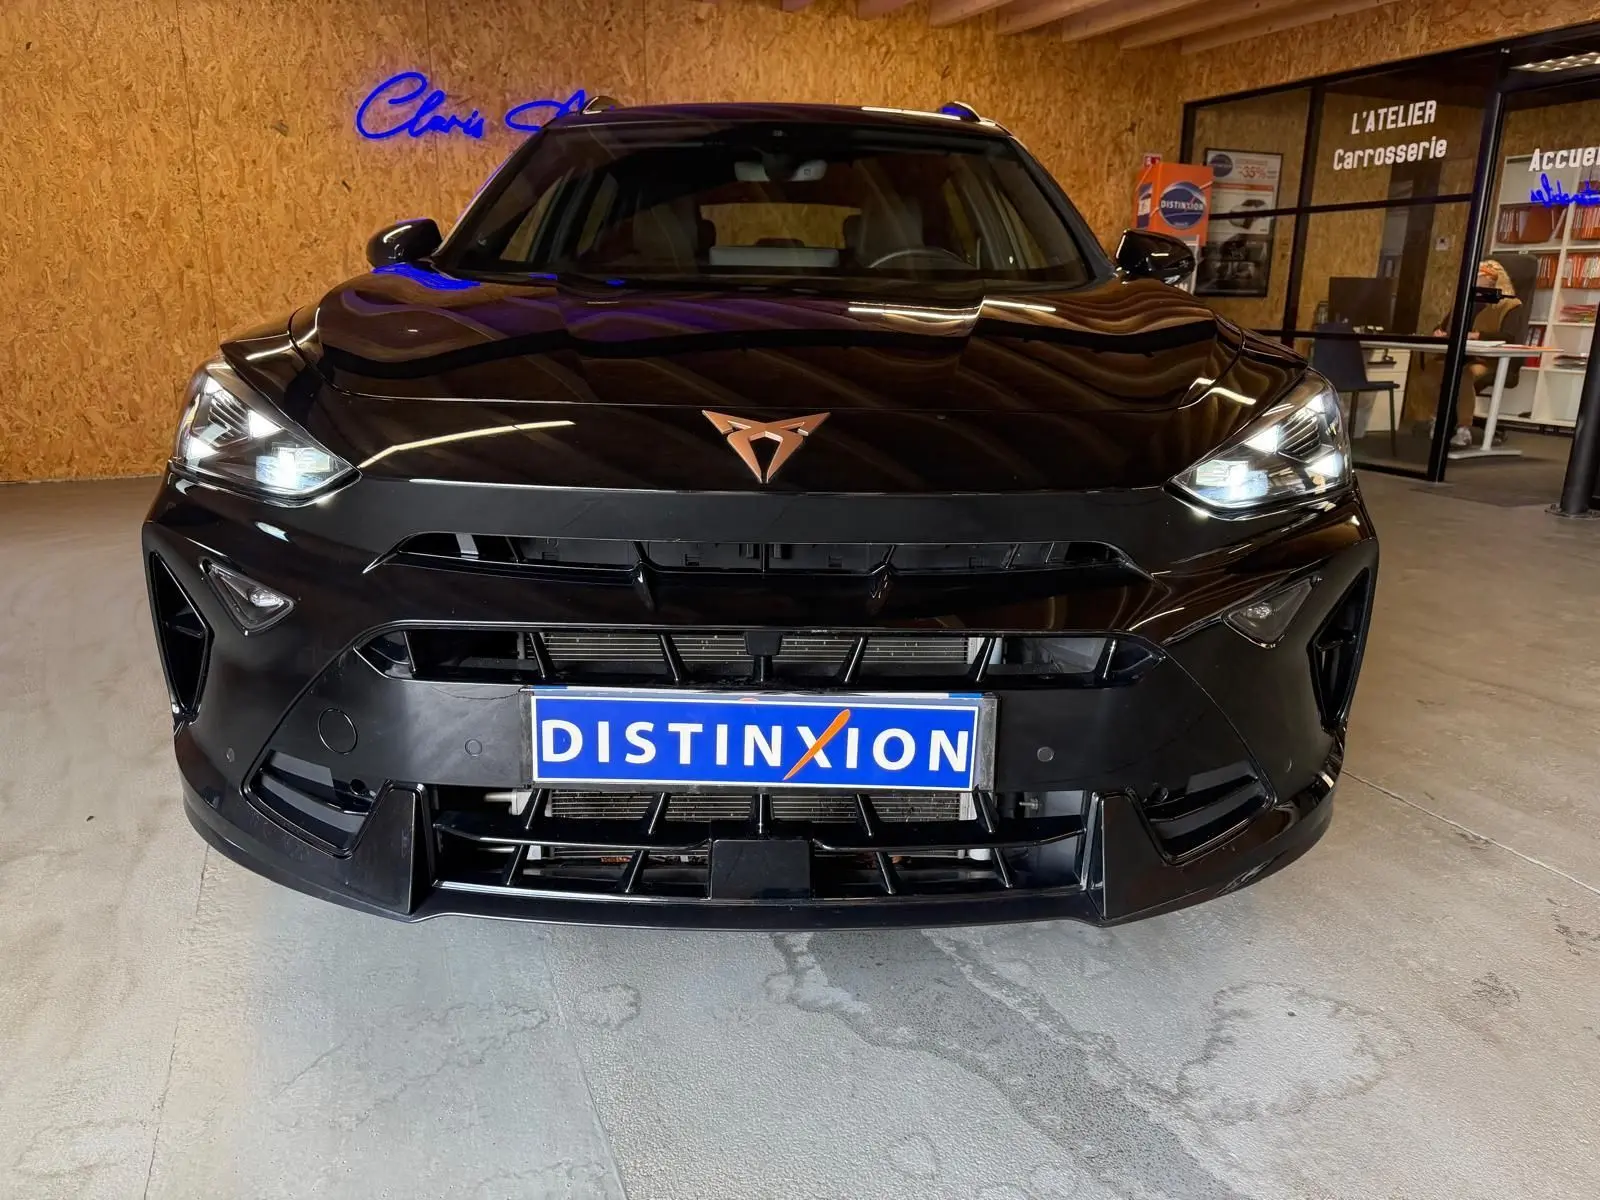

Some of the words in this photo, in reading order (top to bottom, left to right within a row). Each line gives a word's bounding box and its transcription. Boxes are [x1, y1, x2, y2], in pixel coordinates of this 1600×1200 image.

[1351, 100, 1437, 135] L'ATELIER
[1332, 136, 1448, 171] Carrosserie
[1160, 198, 1204, 211] DISTINXION
[541, 709, 969, 780] DISTINXION
